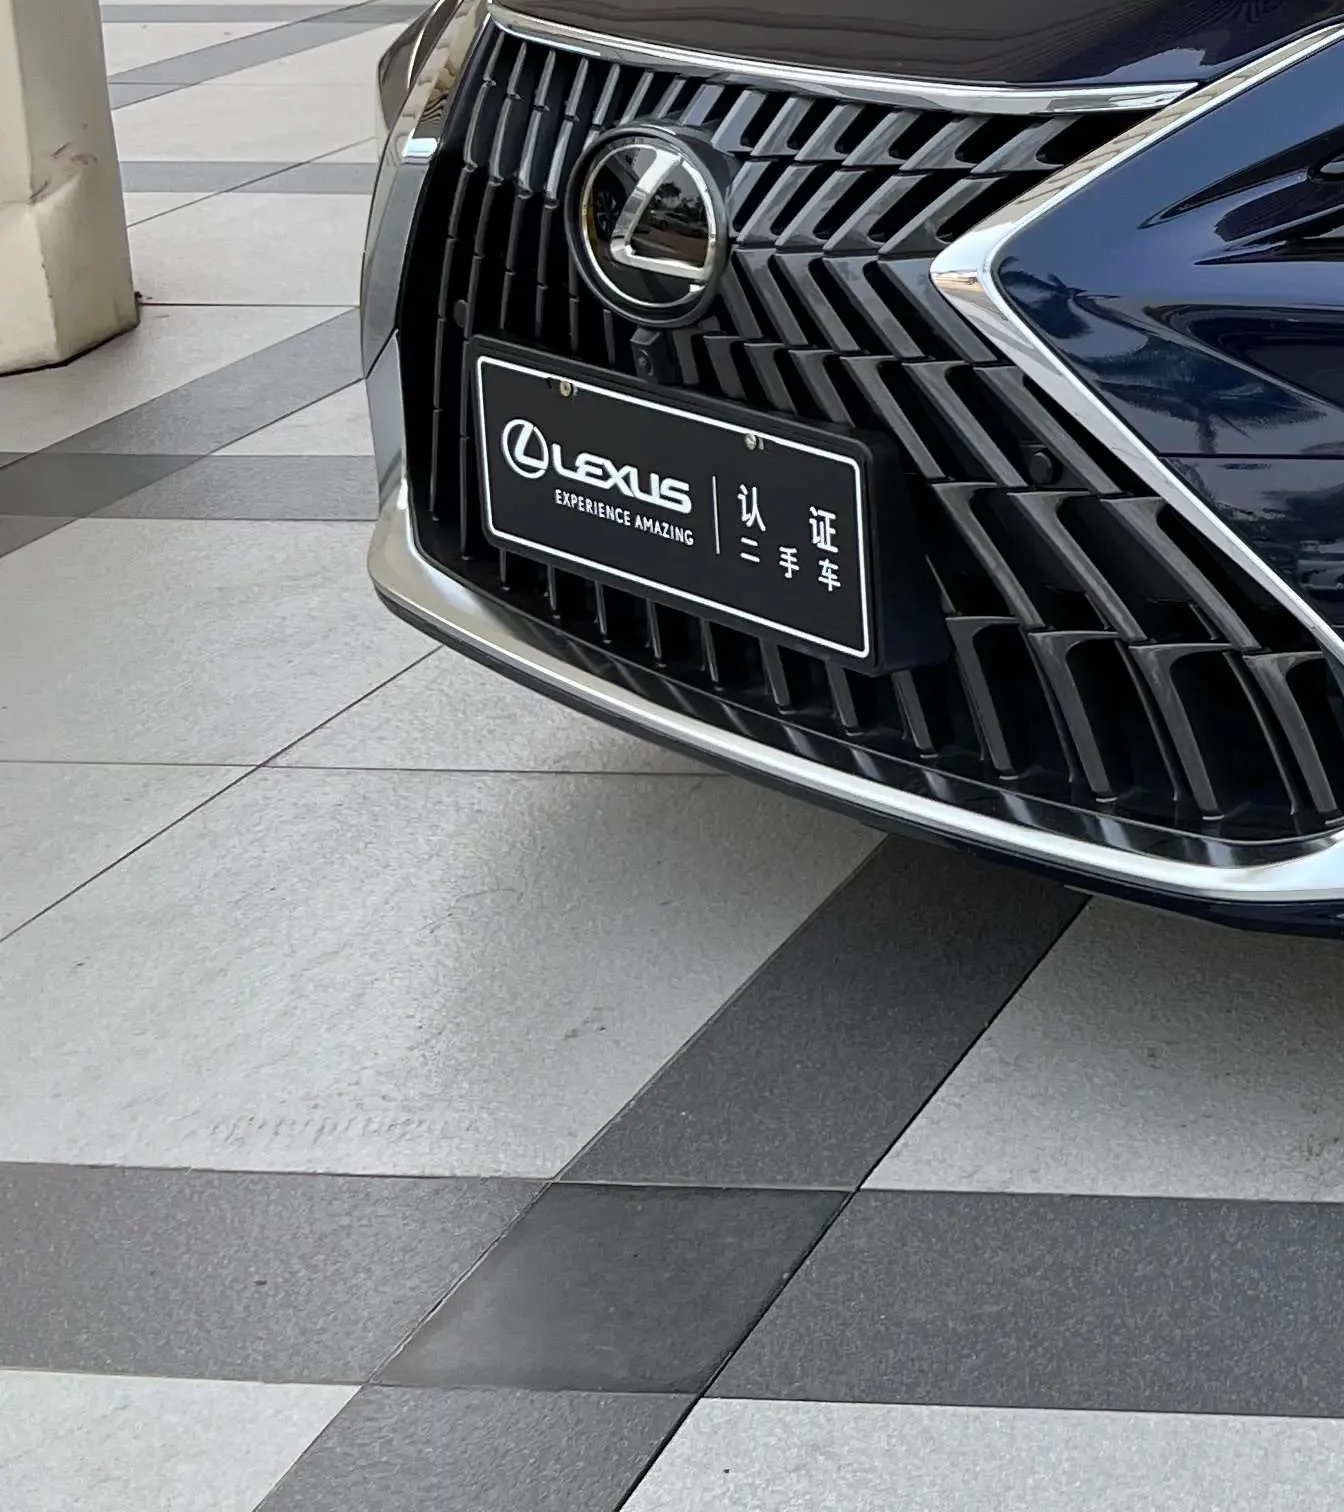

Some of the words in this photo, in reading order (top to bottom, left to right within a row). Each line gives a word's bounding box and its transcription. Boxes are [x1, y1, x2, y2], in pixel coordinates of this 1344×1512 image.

[552, 443, 692, 515] LEXUS
[555, 488, 632, 528] EXPERIENCE
[634, 515, 695, 547] AMAZING
[737, 484, 839, 554] 认证
[740, 536, 842, 592] 二手车
